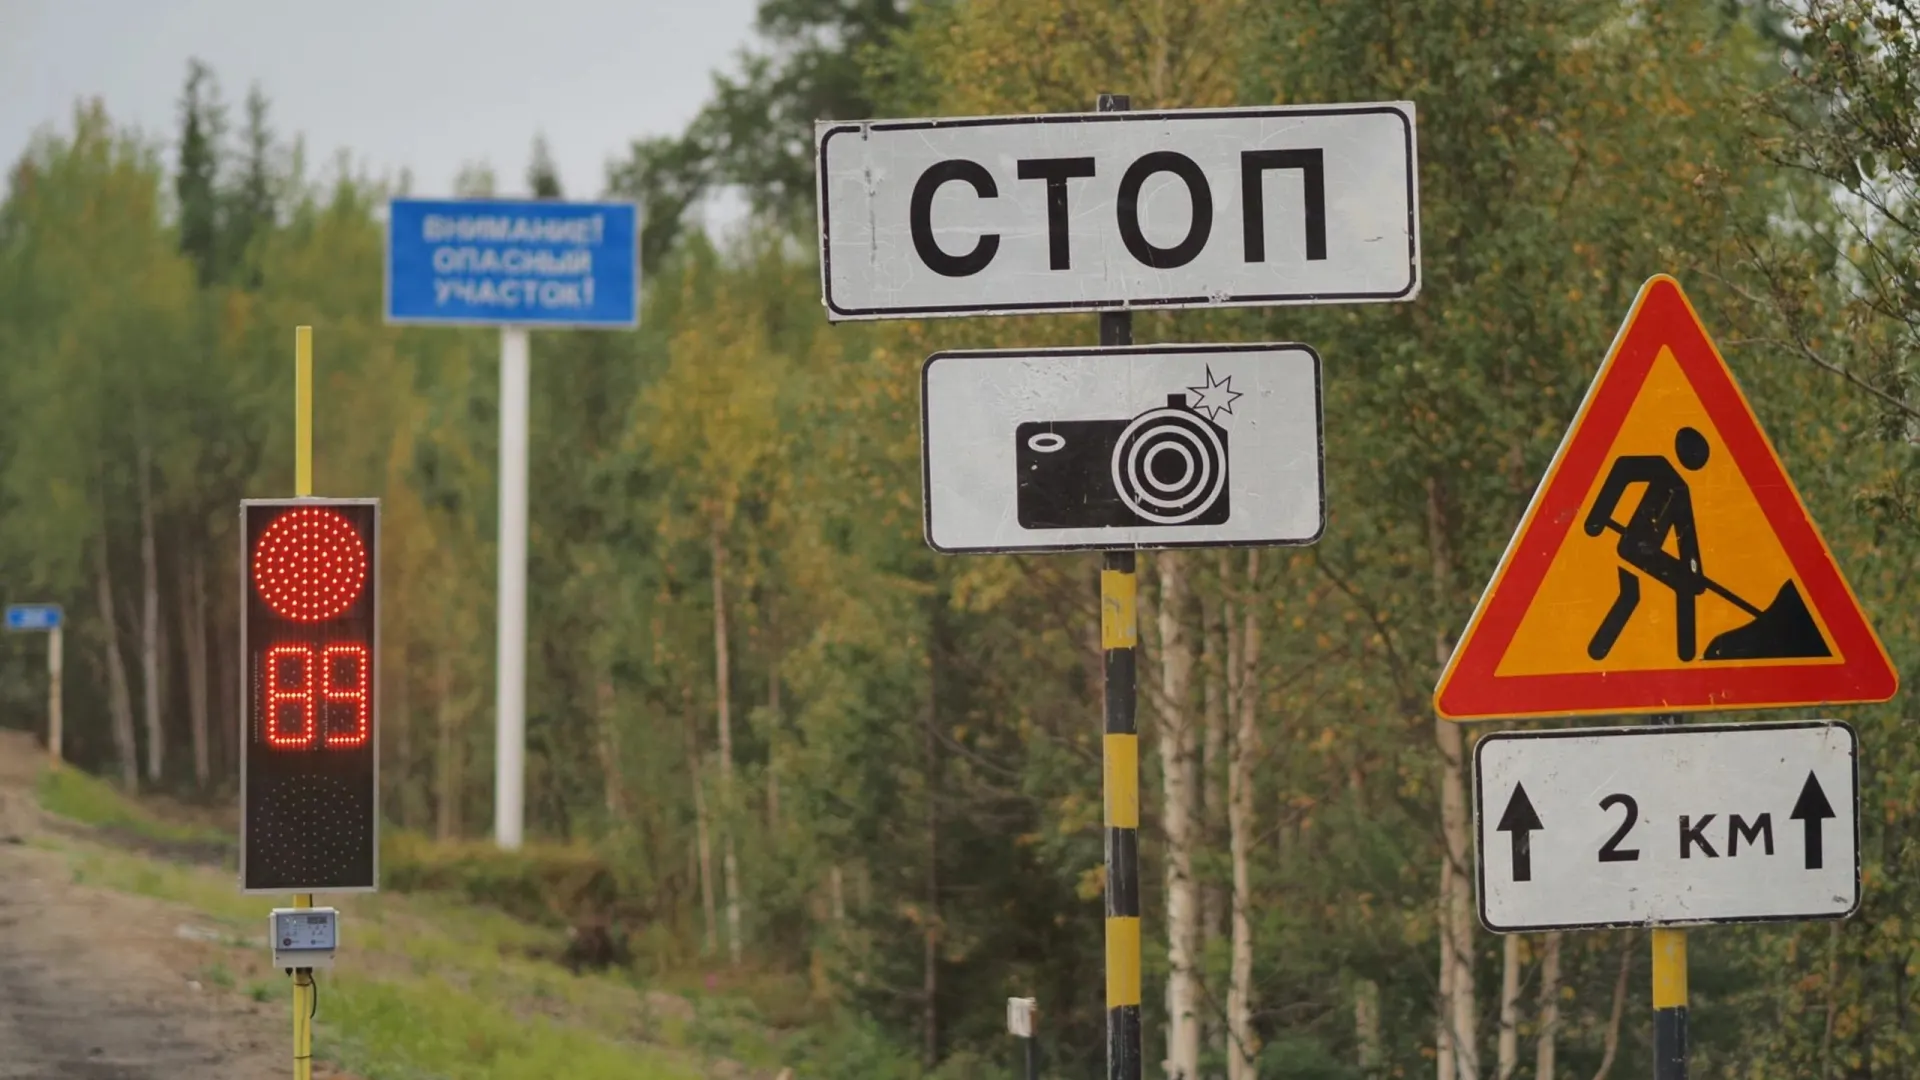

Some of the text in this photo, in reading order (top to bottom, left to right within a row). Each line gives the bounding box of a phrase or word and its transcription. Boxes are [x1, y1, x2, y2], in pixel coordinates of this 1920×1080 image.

[422, 214, 604, 244] ВНИМАНИЕ!
[909, 148, 1328, 278] СТОП
[433, 247, 592, 275] ОПАСНЫЙ
[434, 278, 595, 307] УЧАСТОК!
[268, 645, 367, 746] 89
[1597, 793, 1775, 863] 2 км
